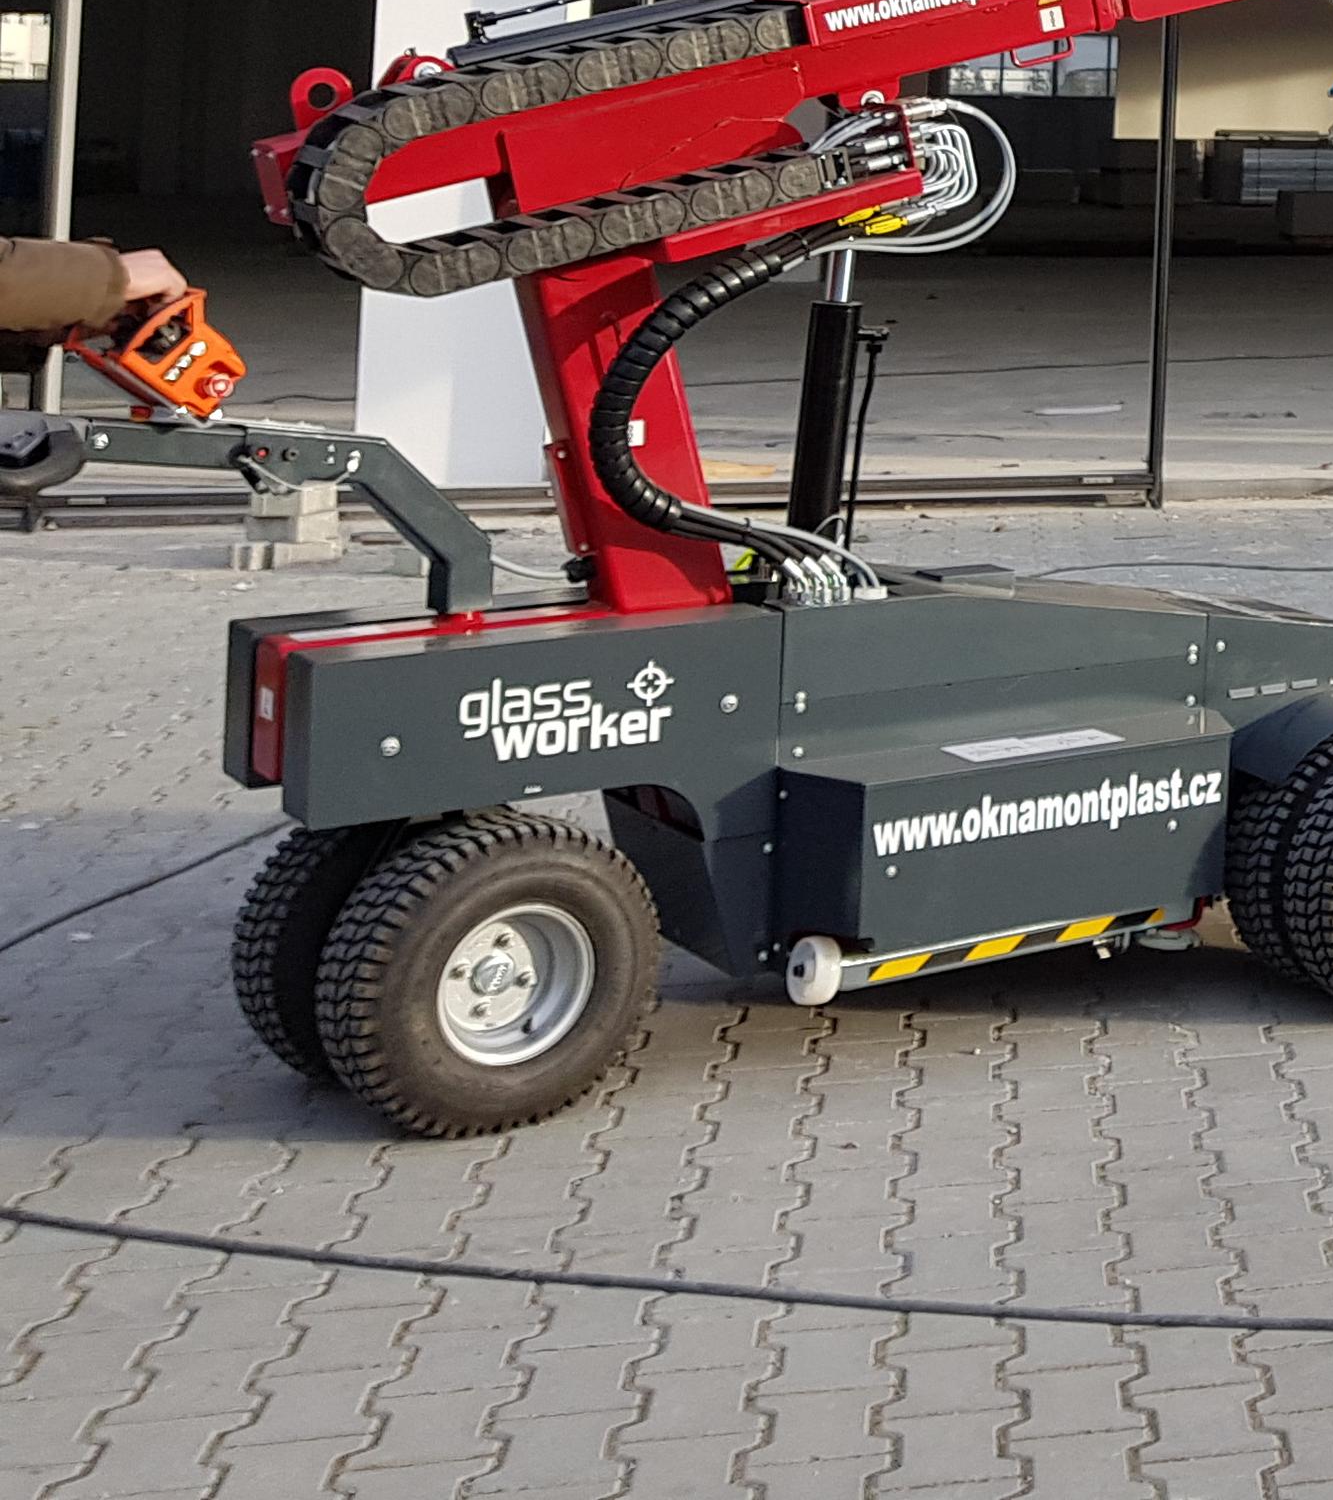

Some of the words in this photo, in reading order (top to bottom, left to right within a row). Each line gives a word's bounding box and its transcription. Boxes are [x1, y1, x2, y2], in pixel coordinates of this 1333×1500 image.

[459, 677, 592, 739] glass
[491, 702, 672, 762] worker
[873, 767, 1222, 857] www.oknamontplast.cz
